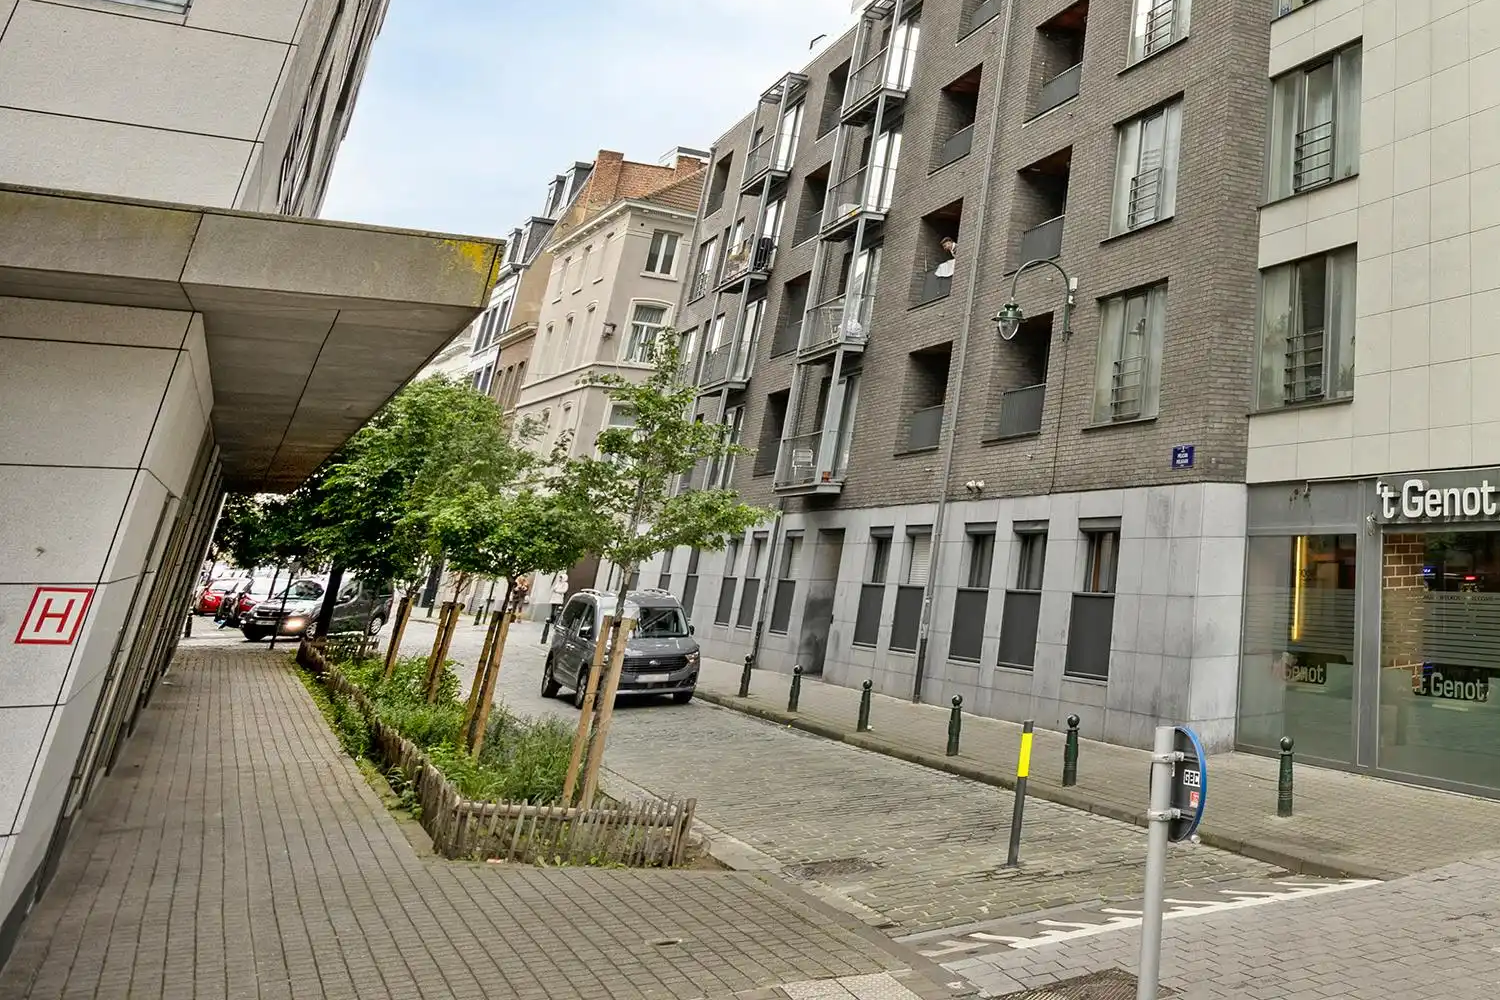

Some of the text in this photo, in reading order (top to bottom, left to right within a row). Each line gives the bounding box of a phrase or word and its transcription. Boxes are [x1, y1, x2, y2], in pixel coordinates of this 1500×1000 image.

[1376, 479, 1497, 519] 't Genot
[33, 598, 76, 633] H
[1430, 671, 1487, 701] Genot
